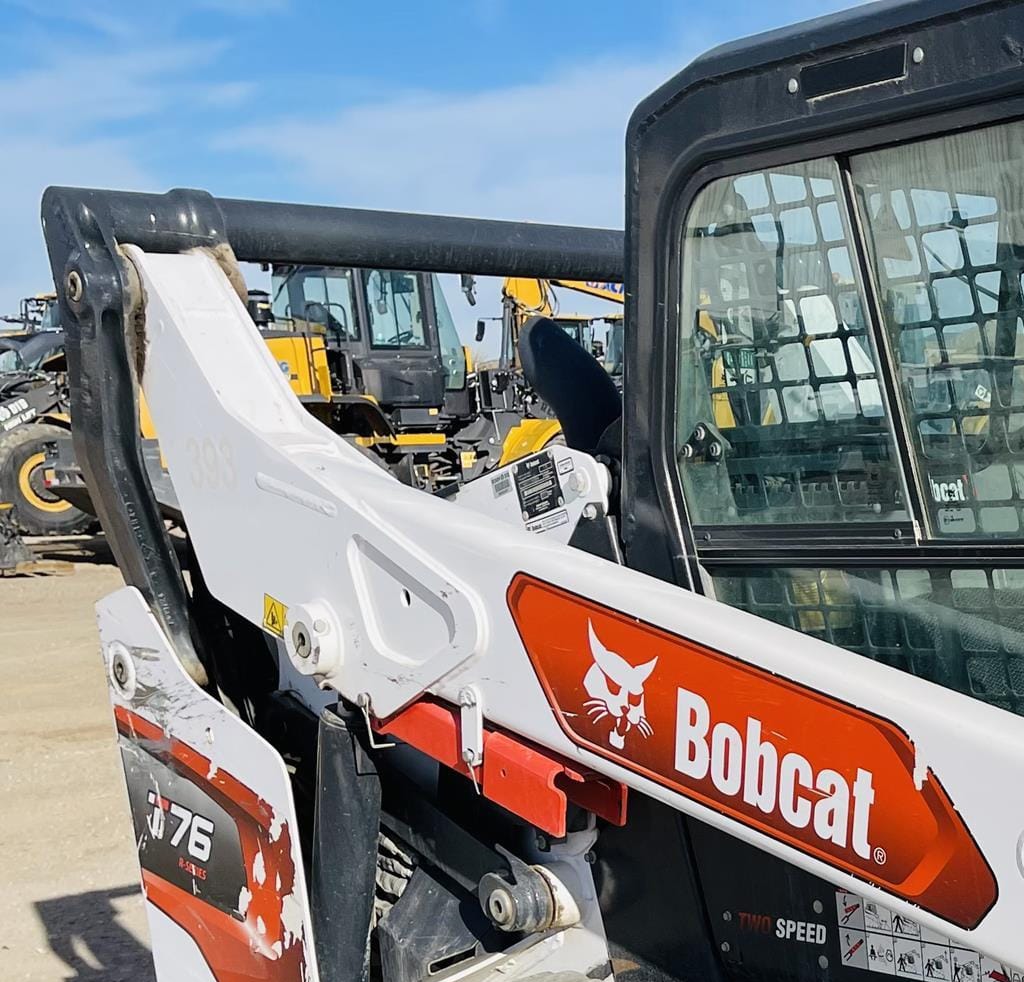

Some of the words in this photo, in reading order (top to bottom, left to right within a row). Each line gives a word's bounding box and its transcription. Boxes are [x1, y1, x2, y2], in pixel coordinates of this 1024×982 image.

[185, 436, 240, 492] 393
[739, 911, 772, 935] TWO
[775, 917, 828, 946] SPEED
